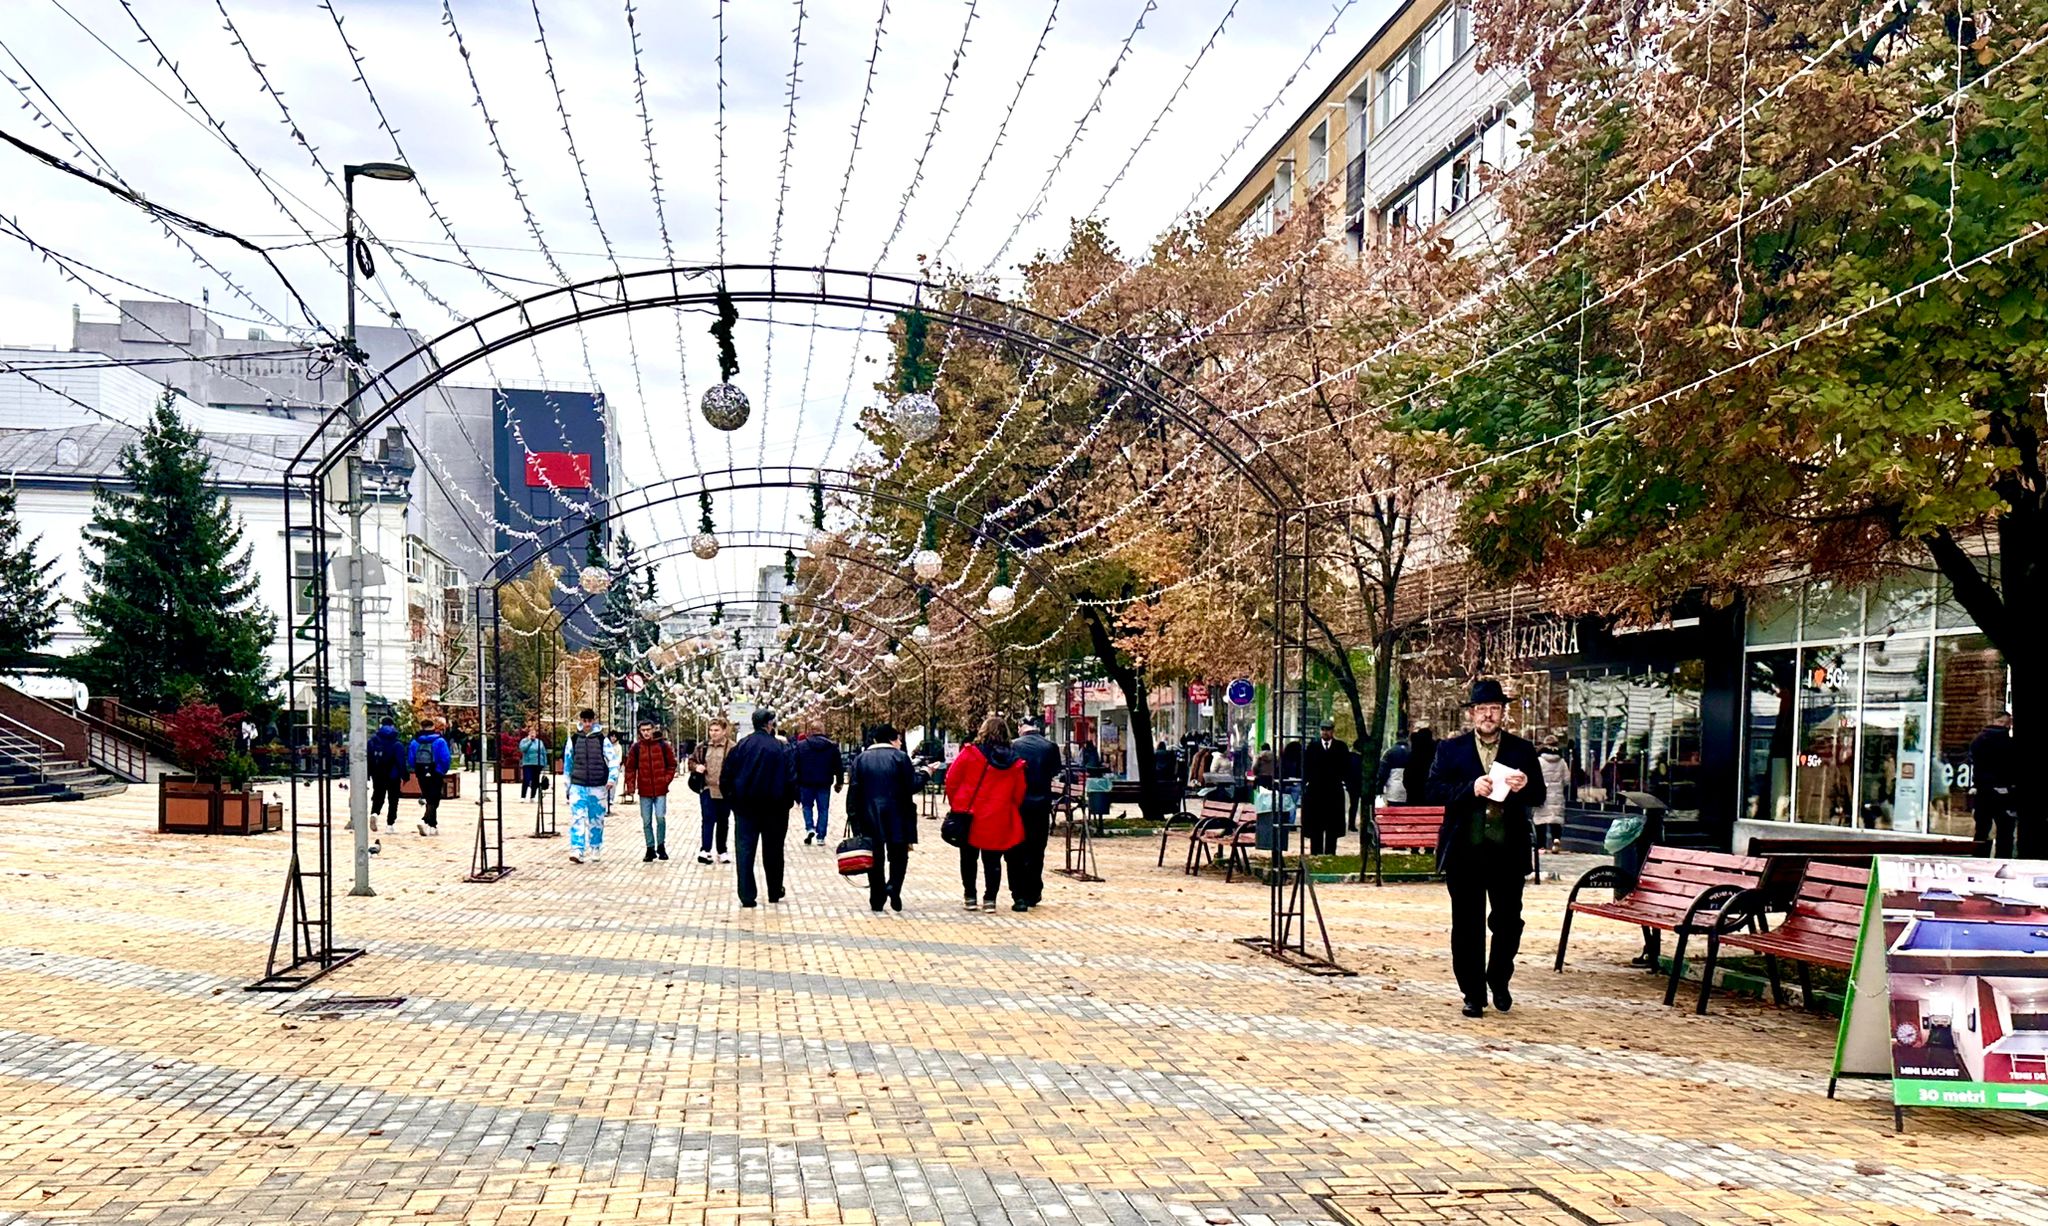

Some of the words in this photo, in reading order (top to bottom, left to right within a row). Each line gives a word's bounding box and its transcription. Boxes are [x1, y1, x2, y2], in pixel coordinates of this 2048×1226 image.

[1826, 667, 1849, 688] 5G+
[1807, 754, 1822, 767] 5G+
[1886, 861, 1963, 879] ILIARD
[1900, 1066, 1920, 1075] MINI
[1921, 1067, 1960, 1077] BASCHET
[2009, 1071, 2033, 1080] TENIS
[1918, 1088, 1939, 1101] 30
[1942, 1090, 1986, 1103] metri
